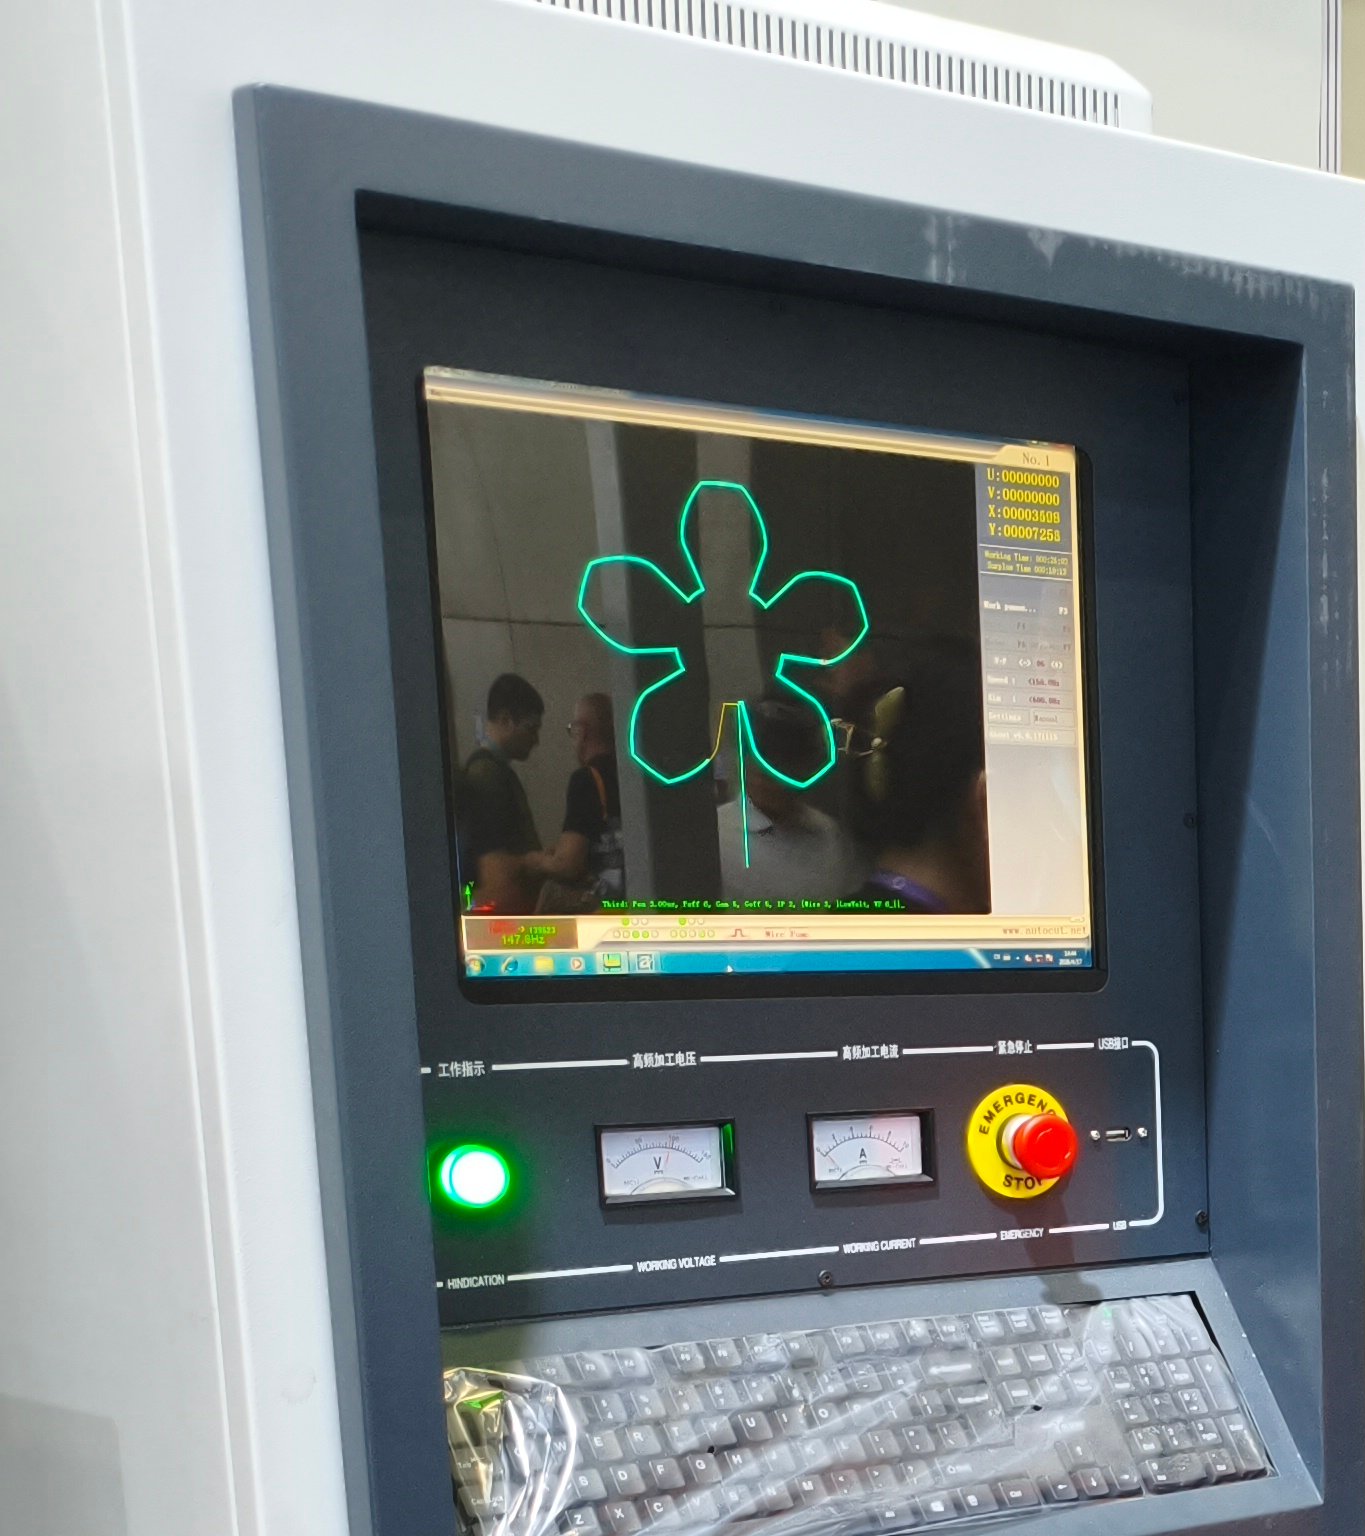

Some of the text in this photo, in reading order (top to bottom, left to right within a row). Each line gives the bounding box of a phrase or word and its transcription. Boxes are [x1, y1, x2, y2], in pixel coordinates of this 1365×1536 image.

[1022, 452, 1041, 465] No.
[842, 1043, 899, 1061] 高频加工电流
[632, 1050, 697, 1070] 高频加工电压
[438, 1060, 486, 1078] 工作指示
[859, 1147, 867, 1159] A
[653, 1156, 662, 1170] V
[1112, 1220, 1127, 1231] USB
[1000, 1228, 1044, 1240] EMERGENCY
[843, 1238, 917, 1254] WORKING CURRENT
[636, 1255, 717, 1273] WORKING VOLTAGE
[447, 1274, 505, 1290] HINDICATION
[818, 1407, 829, 1418] O
[746, 1416, 757, 1428] U
[633, 1432, 644, 1442] R
[672, 1426, 680, 1437] T
[553, 1441, 567, 1451] W
[593, 1436, 605, 1447] E
[731, 1454, 742, 1465] H
[617, 1469, 628, 1481] D
[656, 1464, 666, 1475] F
[578, 1475, 589, 1486] S
[653, 1501, 664, 1512] C
[614, 1507, 625, 1519] X
[573, 1514, 585, 1525] Z
